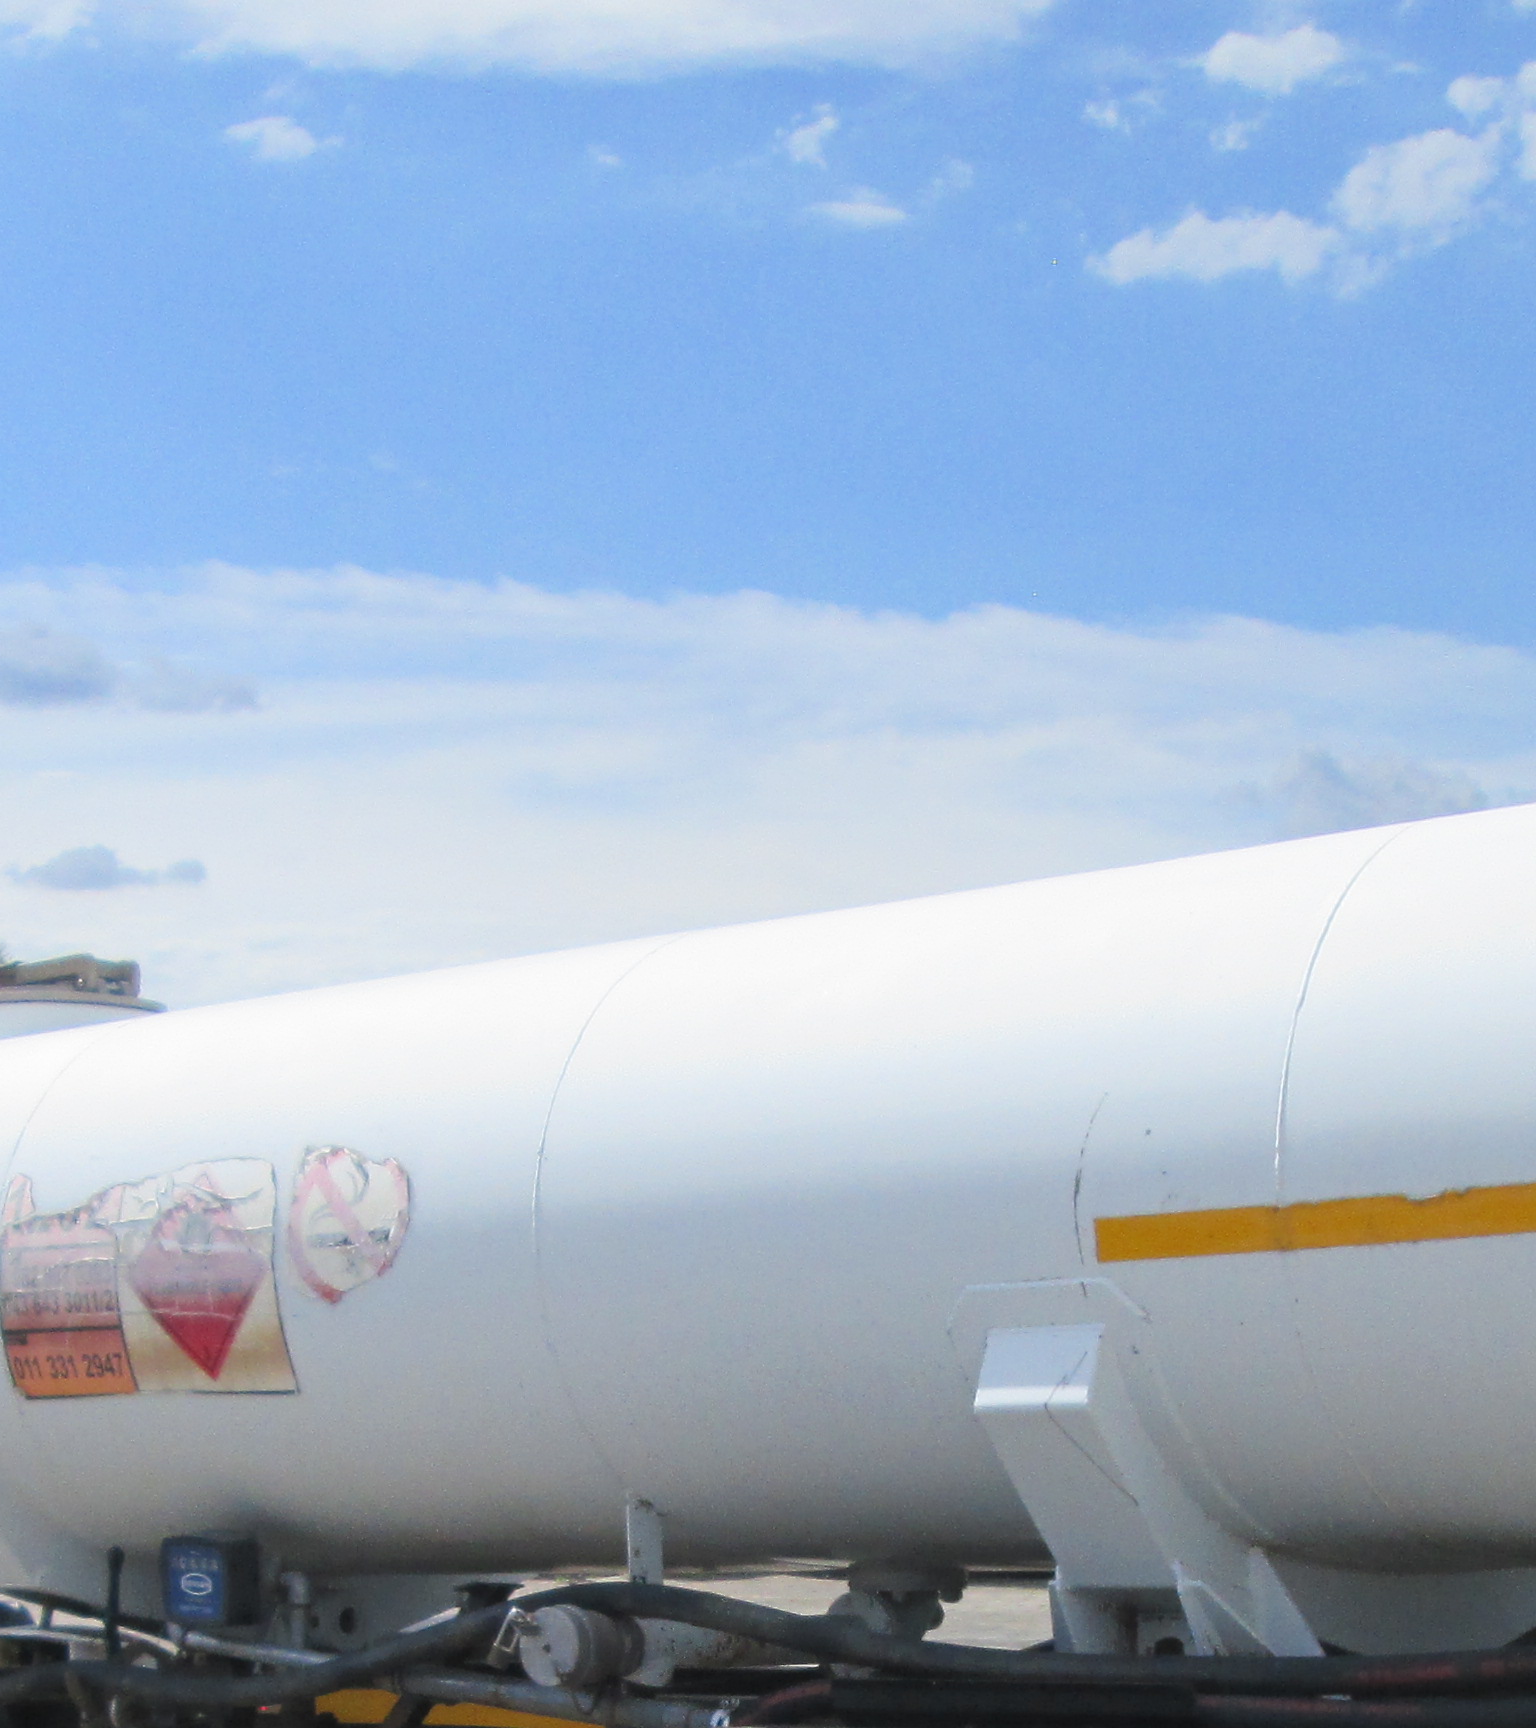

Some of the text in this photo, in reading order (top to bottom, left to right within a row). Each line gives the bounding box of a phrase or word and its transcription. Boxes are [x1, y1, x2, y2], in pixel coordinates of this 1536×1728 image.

[13, 1352, 126, 1381] 011 331 2947
